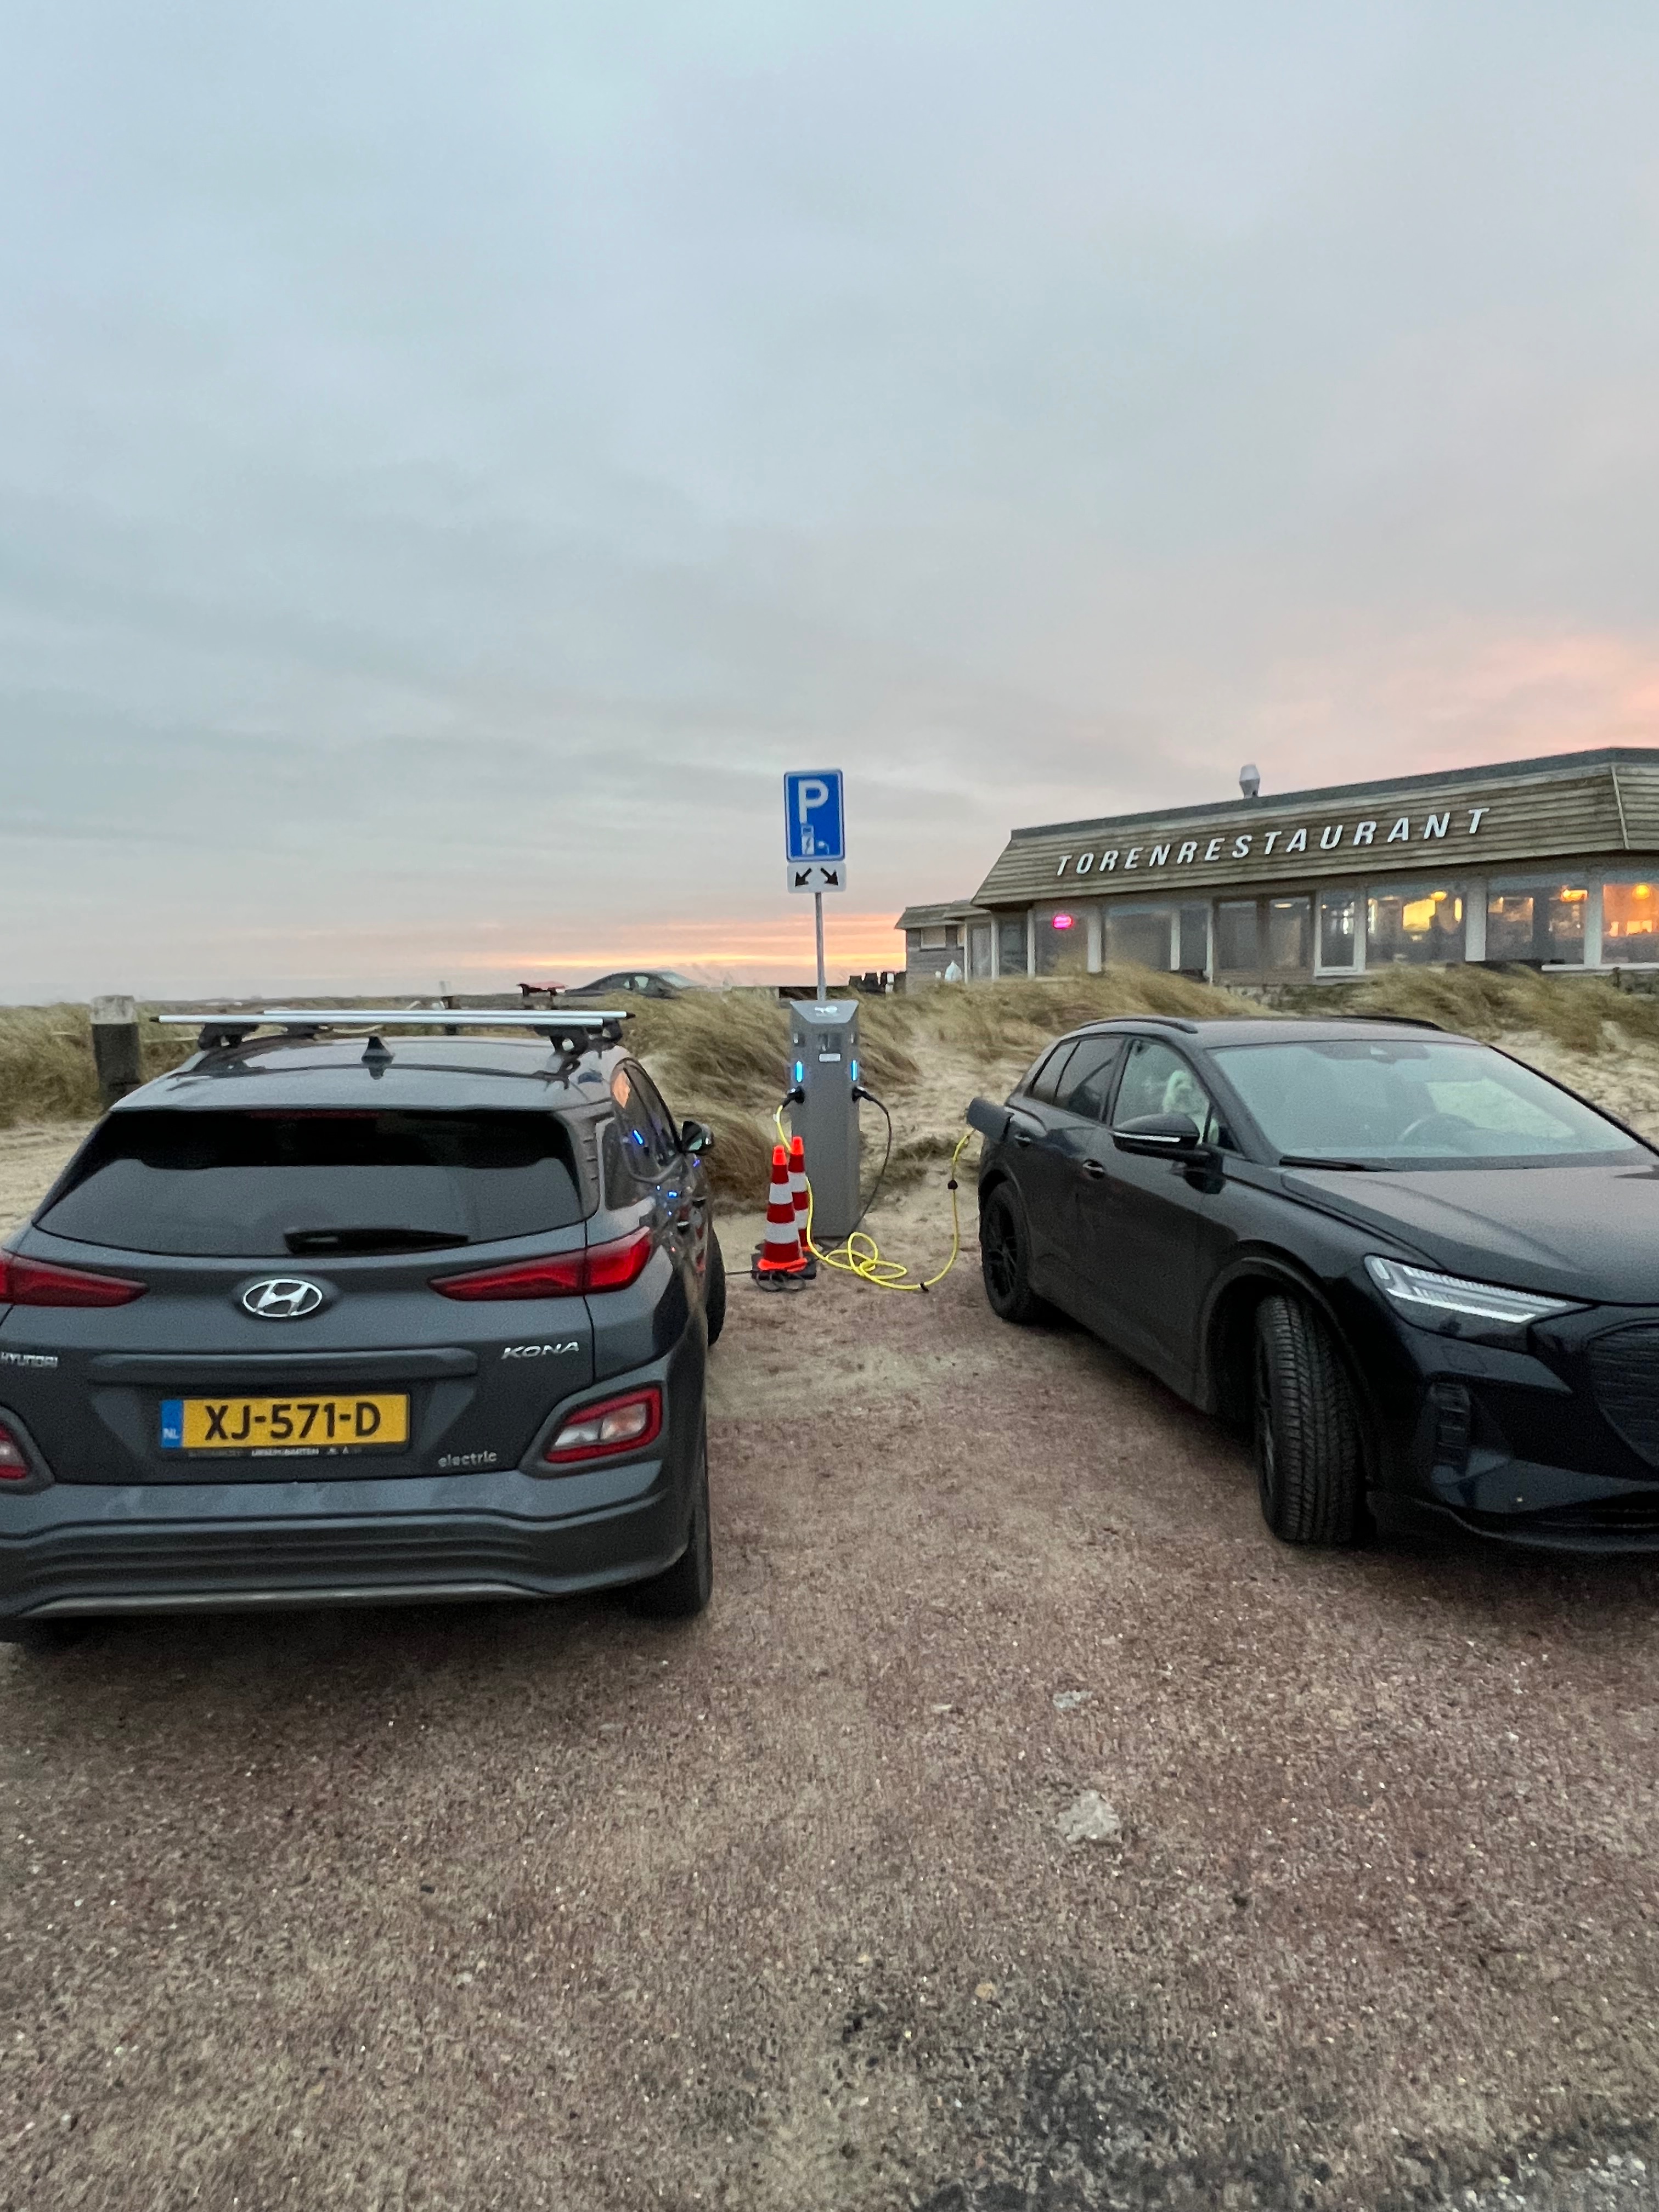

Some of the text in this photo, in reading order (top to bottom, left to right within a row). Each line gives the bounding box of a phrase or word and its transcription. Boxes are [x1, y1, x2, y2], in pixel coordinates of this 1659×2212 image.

[798, 779, 829, 823] P
[1057, 808, 1489, 877] TORENRESTAURANT
[501, 1342, 579, 1359] KONA
[163, 1429, 180, 1440] NL
[205, 1401, 381, 1441] XJ-571-D
[438, 1451, 497, 1468] electric
